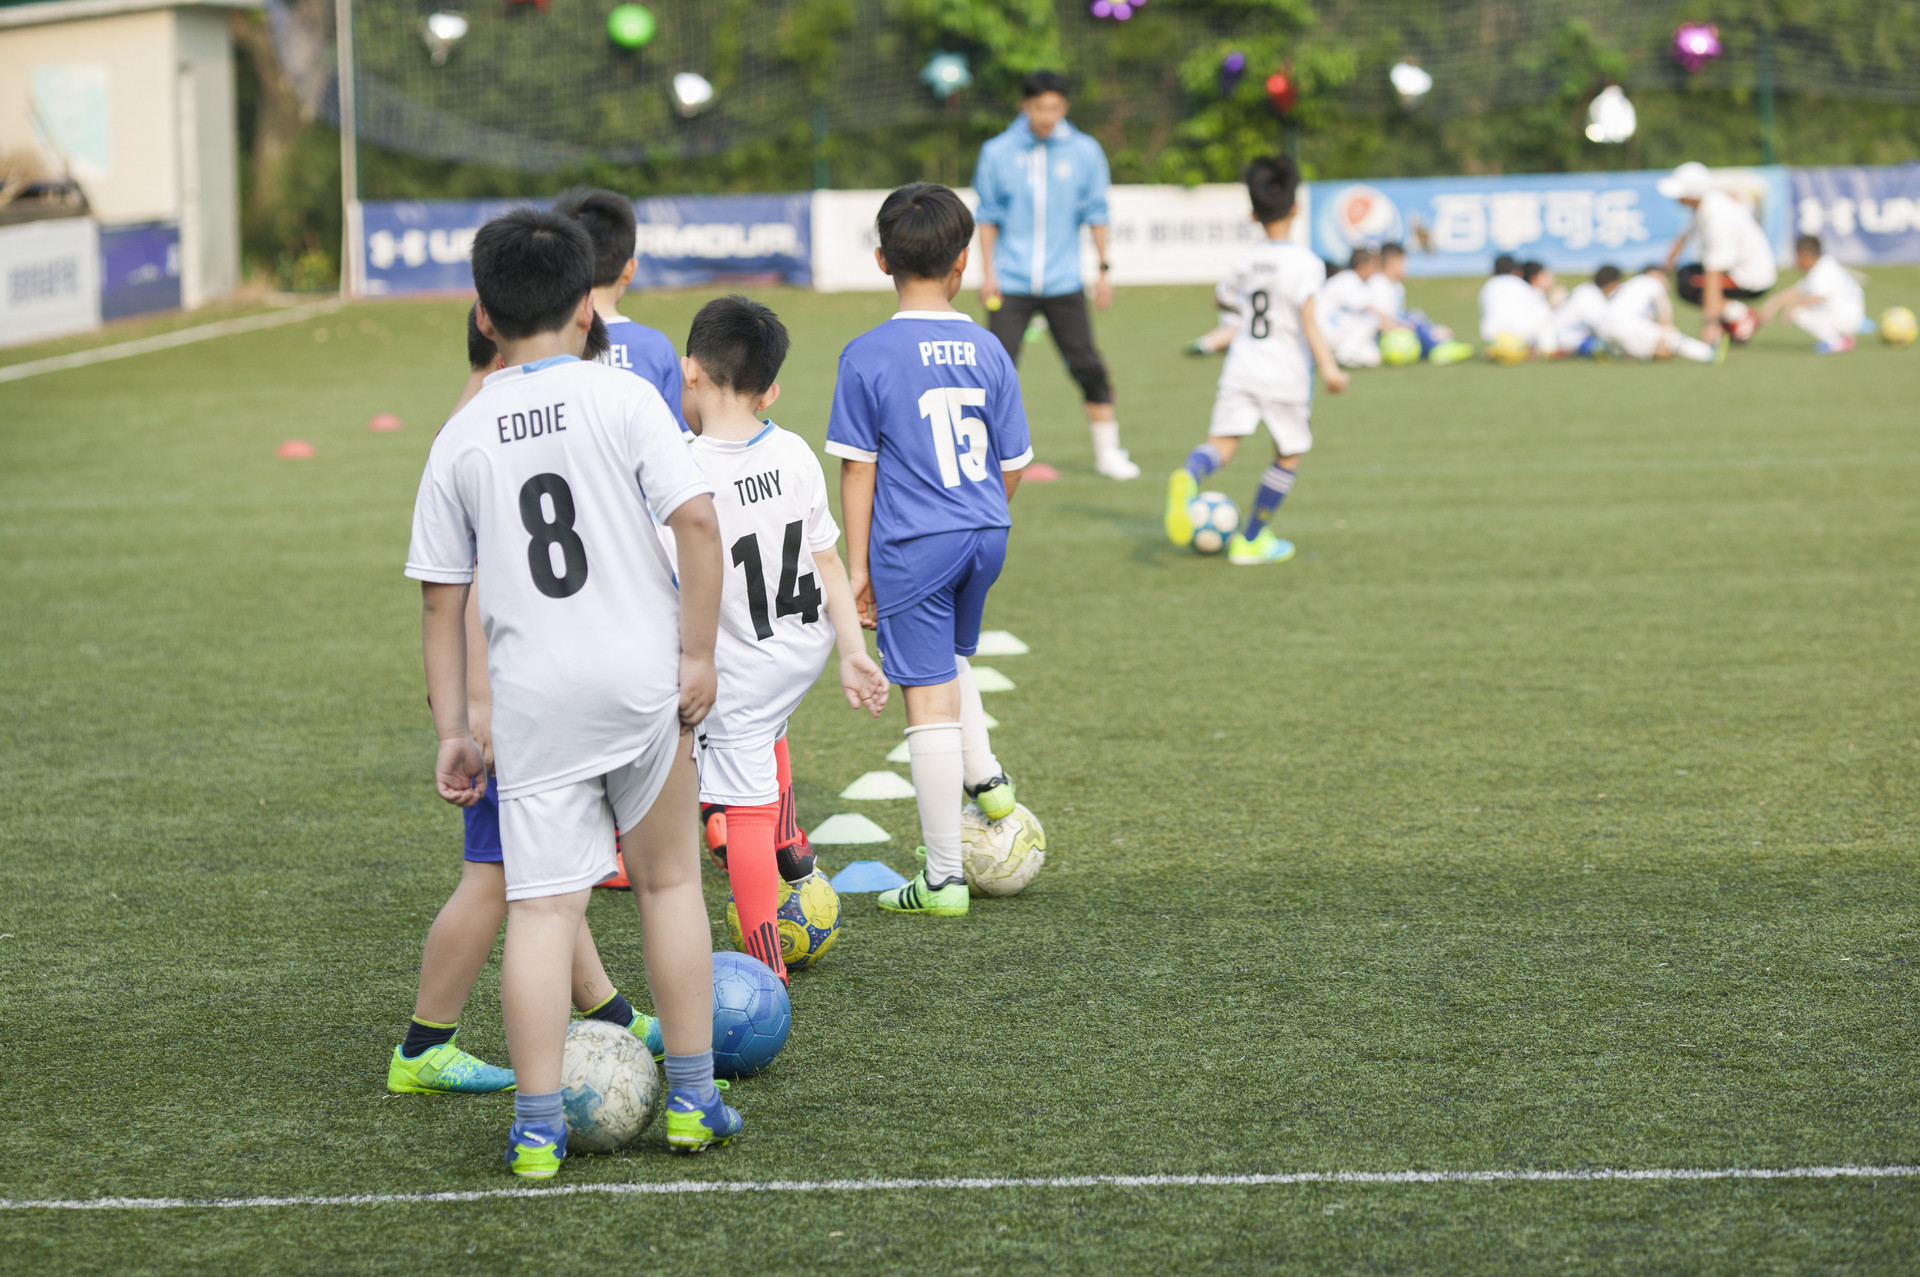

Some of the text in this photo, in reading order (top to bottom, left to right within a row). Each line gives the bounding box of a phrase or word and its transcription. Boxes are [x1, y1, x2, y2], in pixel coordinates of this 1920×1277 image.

[1251, 290, 1270, 340] 8
[917, 340, 977, 367] PETER
[496, 402, 568, 444] EDDIE
[917, 386, 989, 489] 15
[733, 468, 783, 507] TONY
[518, 471, 589, 599] 8
[730, 519, 823, 642] 14
